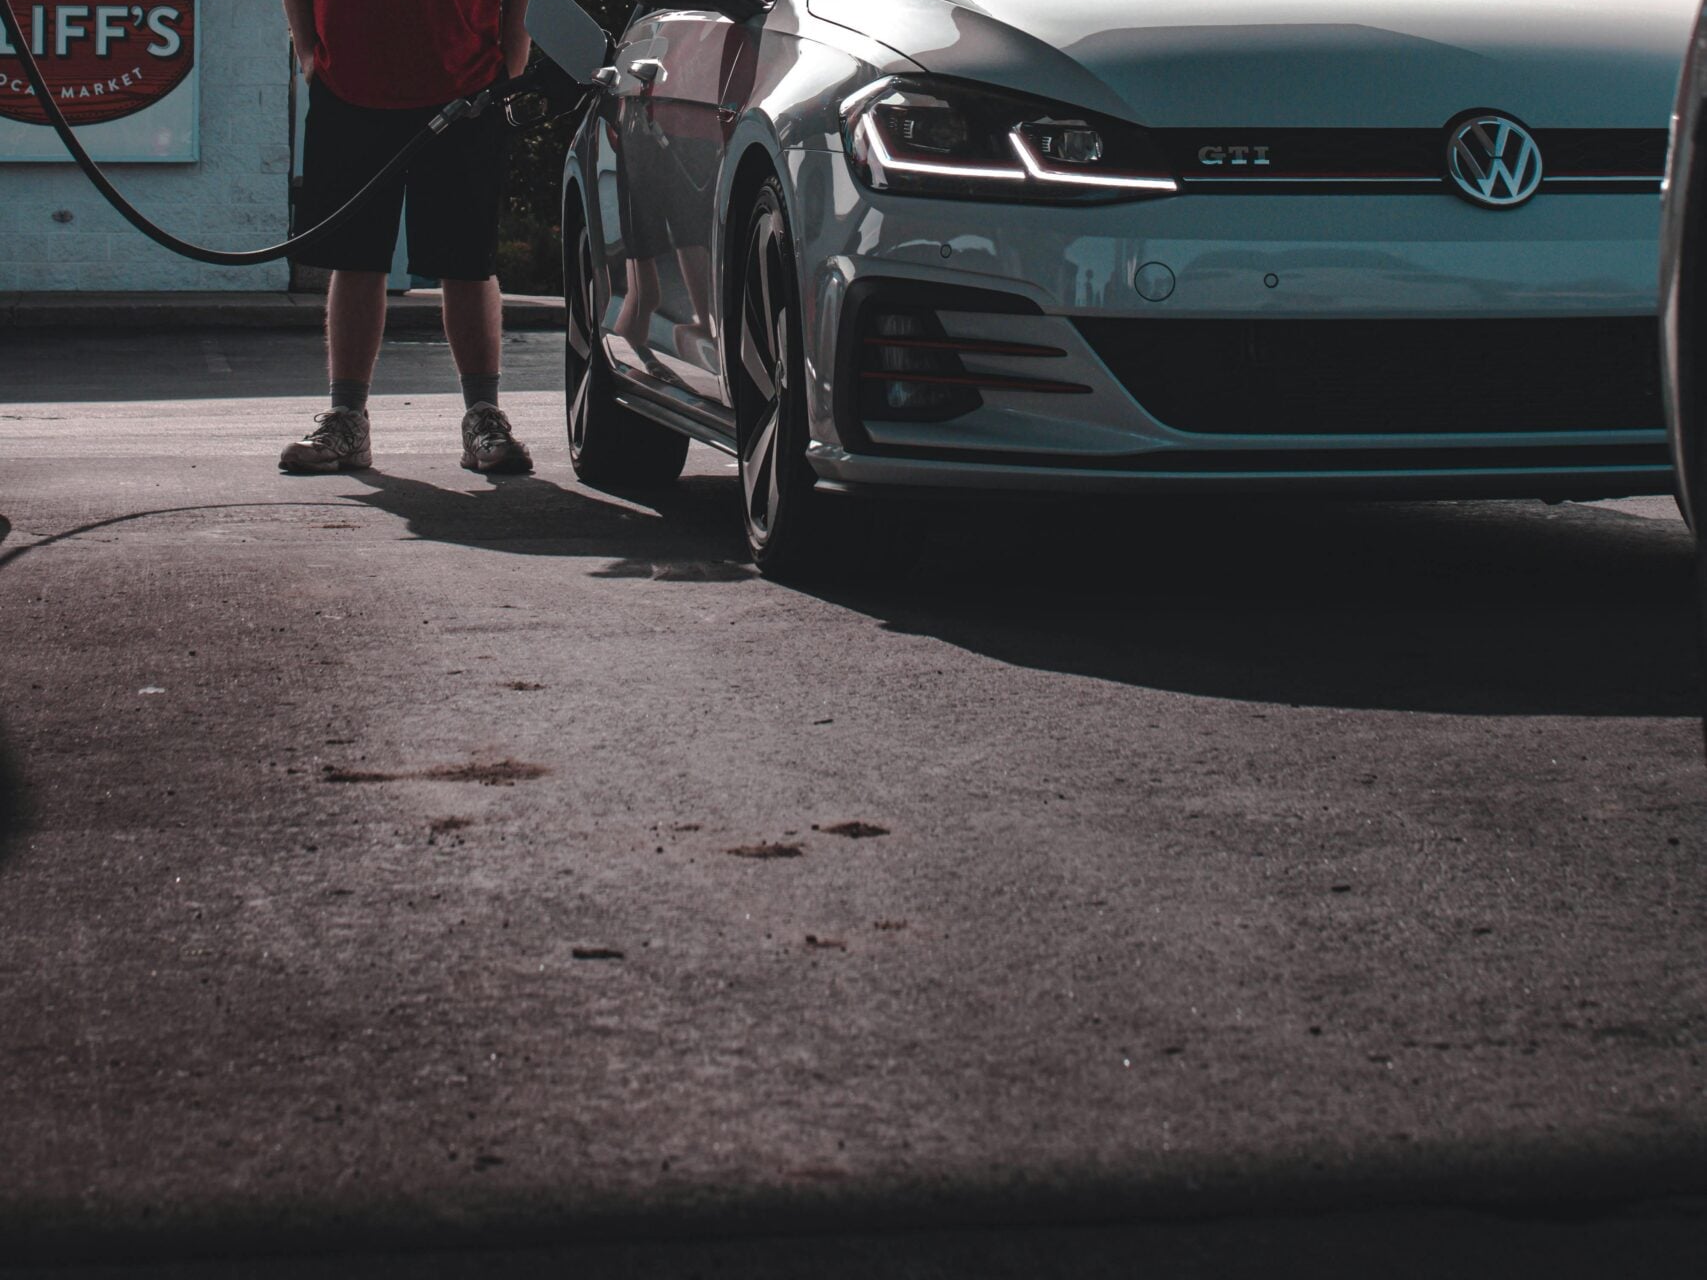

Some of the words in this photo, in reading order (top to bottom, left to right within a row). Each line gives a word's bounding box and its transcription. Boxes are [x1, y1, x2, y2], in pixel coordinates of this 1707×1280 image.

[0, 73, 38, 96] OCA
[61, 66, 144, 99] MARKET
[1198, 145, 1270, 165] GTI
